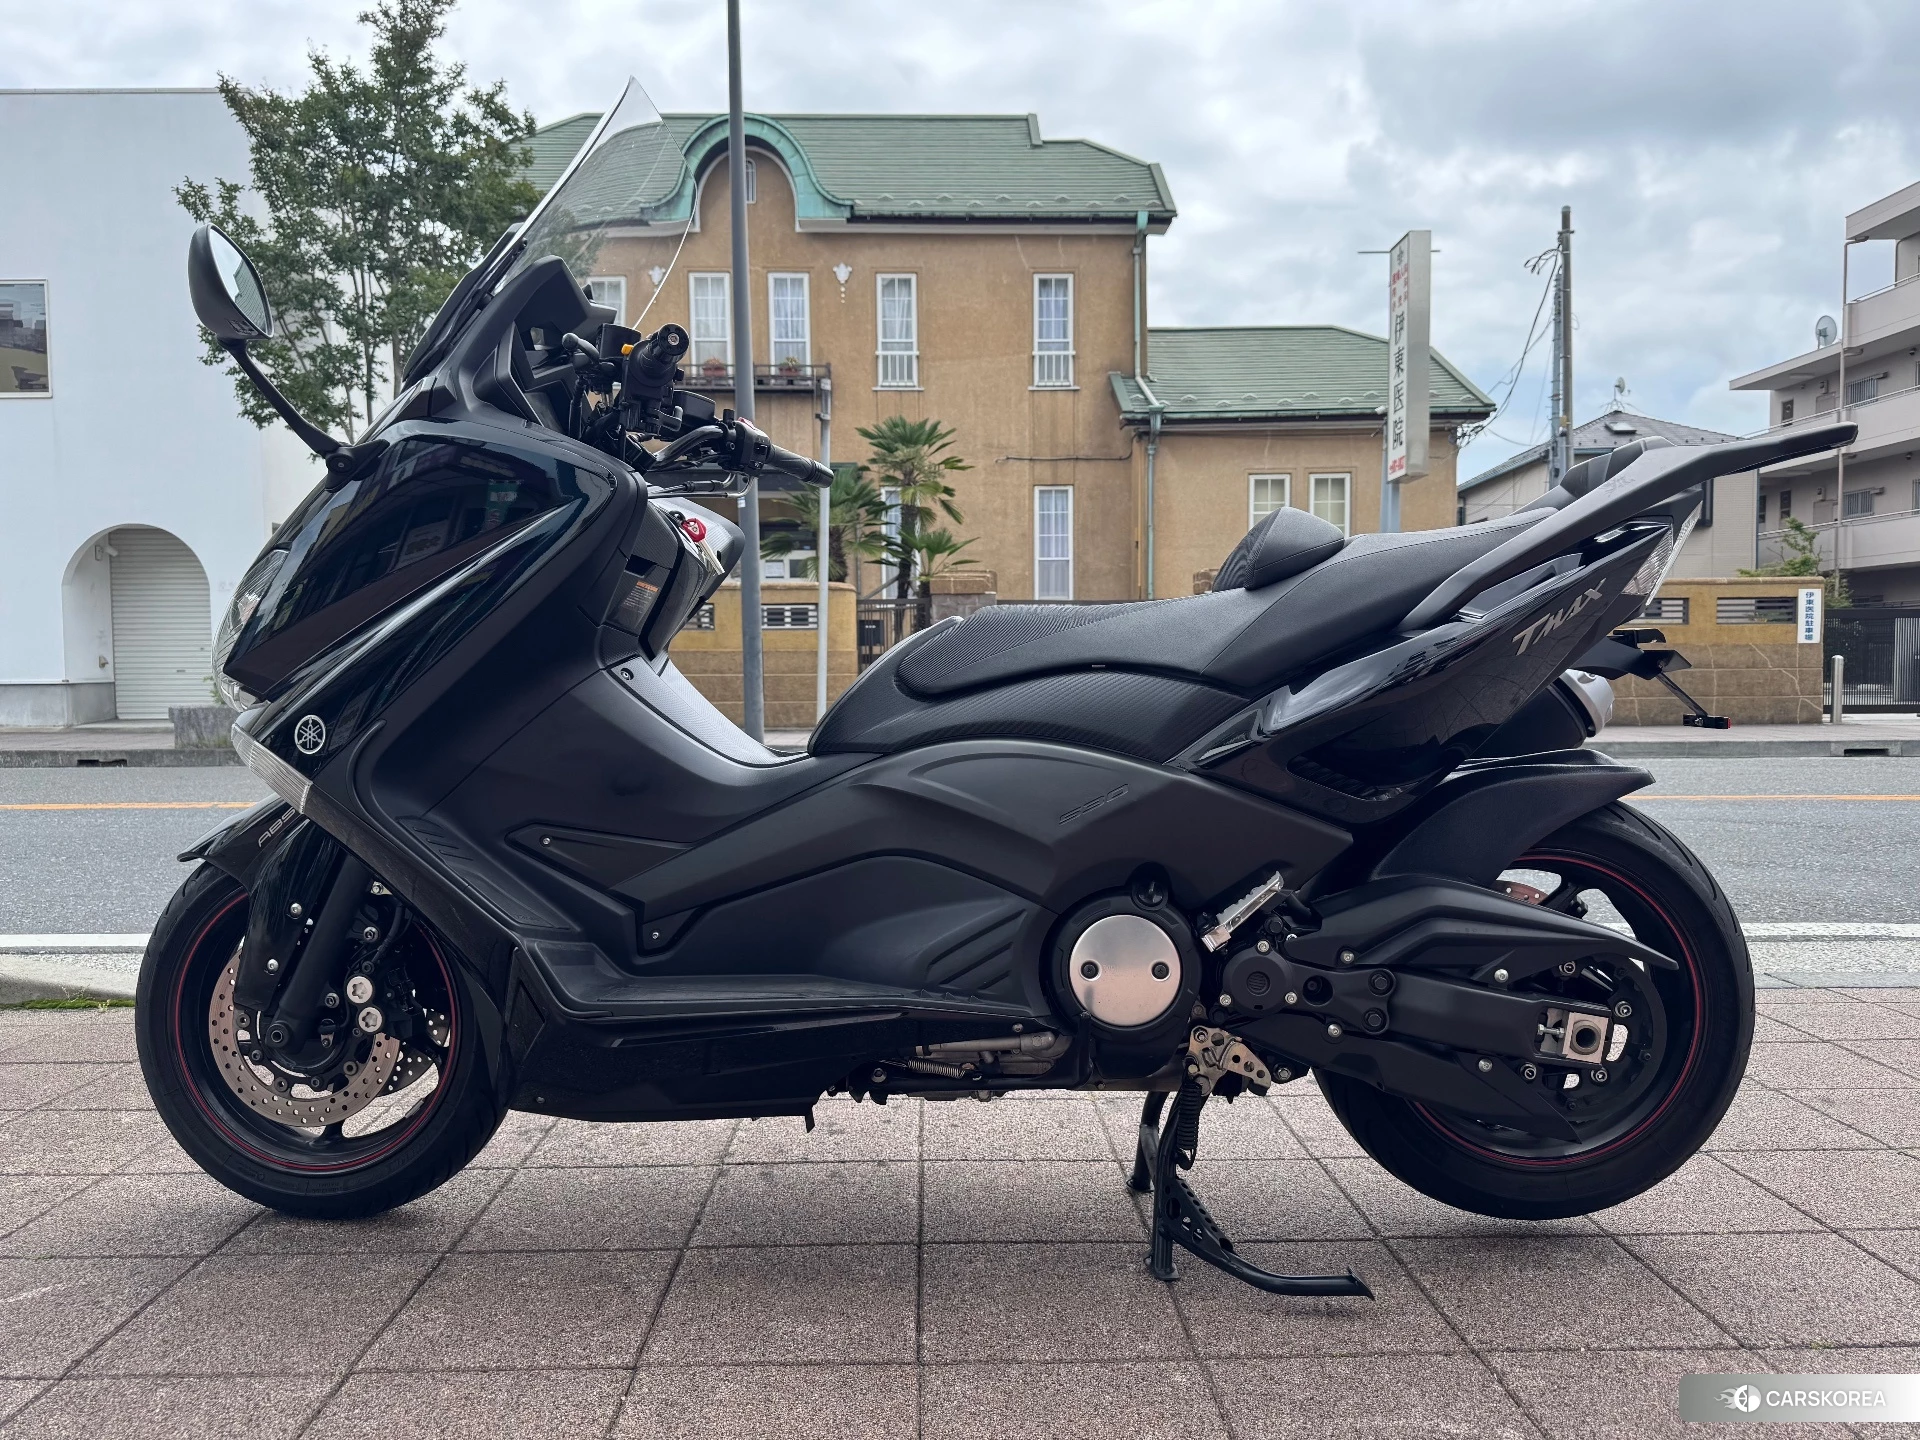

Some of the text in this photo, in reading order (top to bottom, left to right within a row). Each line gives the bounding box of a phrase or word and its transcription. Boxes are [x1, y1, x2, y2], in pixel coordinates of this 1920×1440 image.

[1393, 311, 1405, 450] 伊東医院
[1511, 577, 1607, 656] TMAX
[1804, 591, 1815, 641] 伊東医院駐車場
[258, 807, 296, 848] ABS
